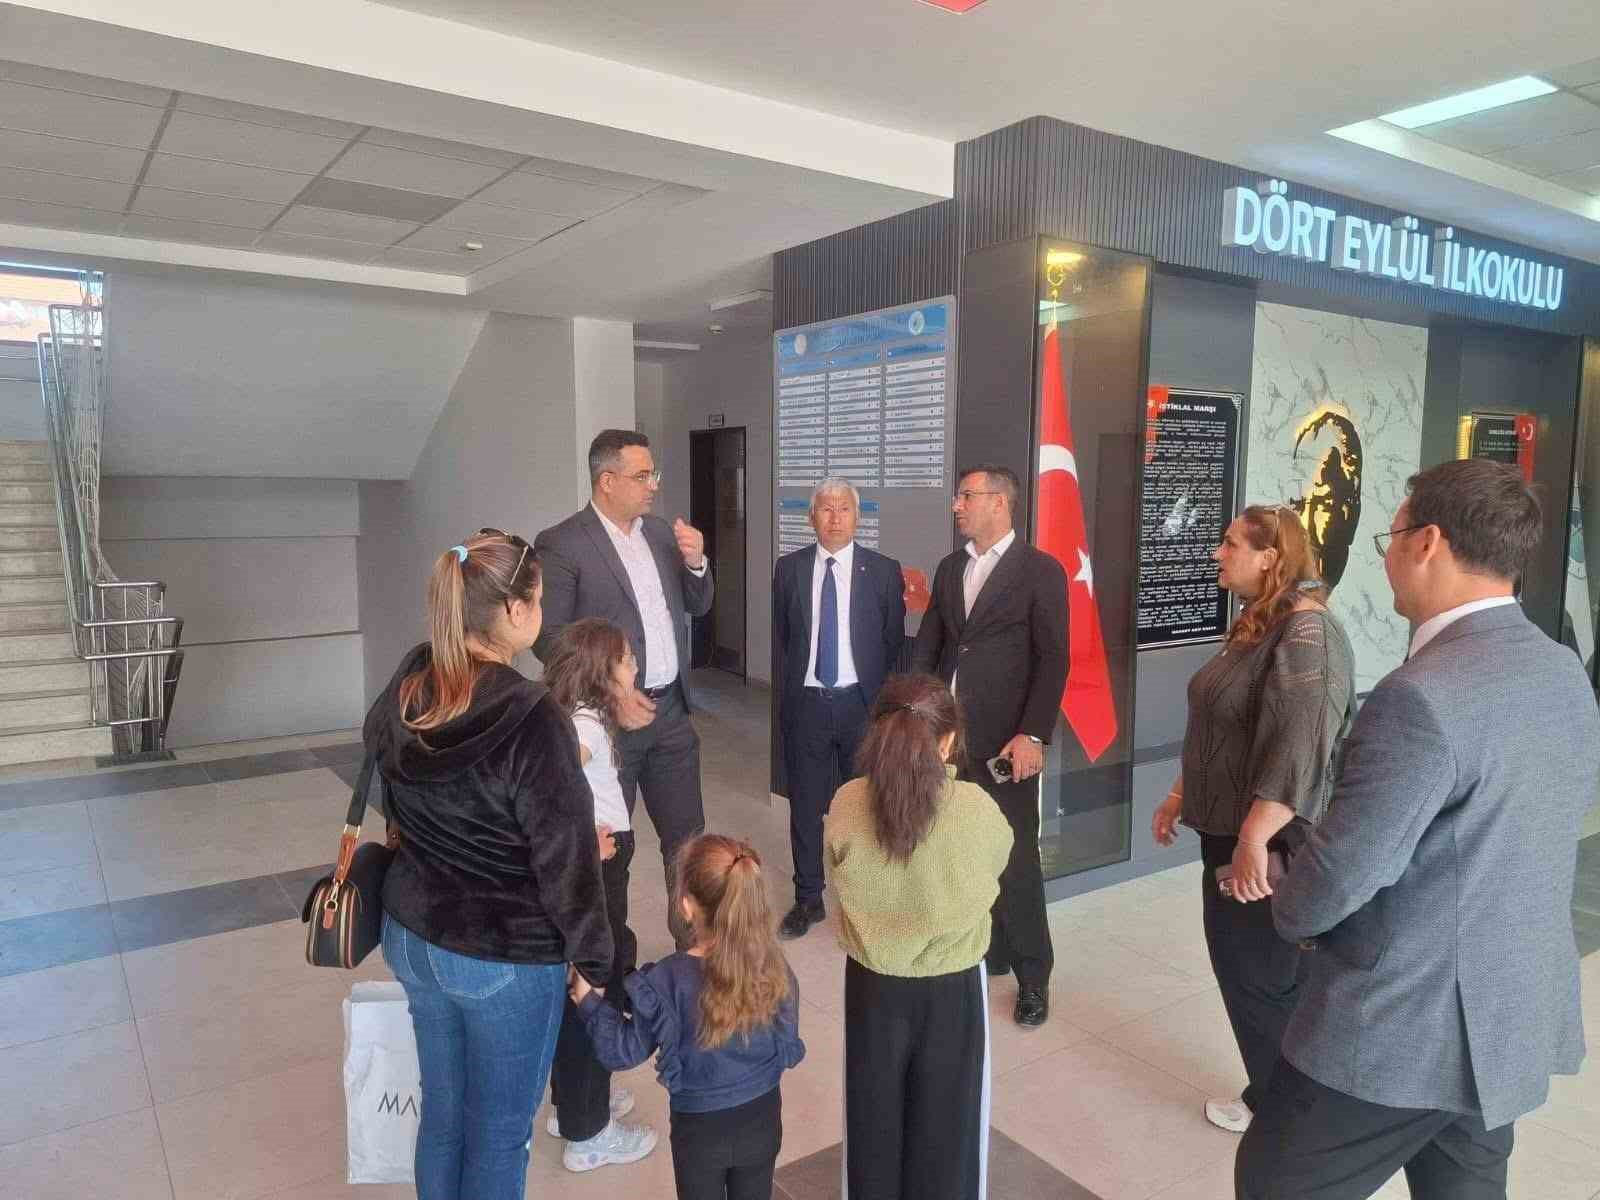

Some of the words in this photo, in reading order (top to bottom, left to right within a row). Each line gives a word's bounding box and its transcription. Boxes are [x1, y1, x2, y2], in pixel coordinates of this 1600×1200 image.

[1231, 179, 1336, 263] DÖRT
[1341, 215, 1435, 285] EYLÜL
[1441, 226, 1564, 311] İLKOKULU
